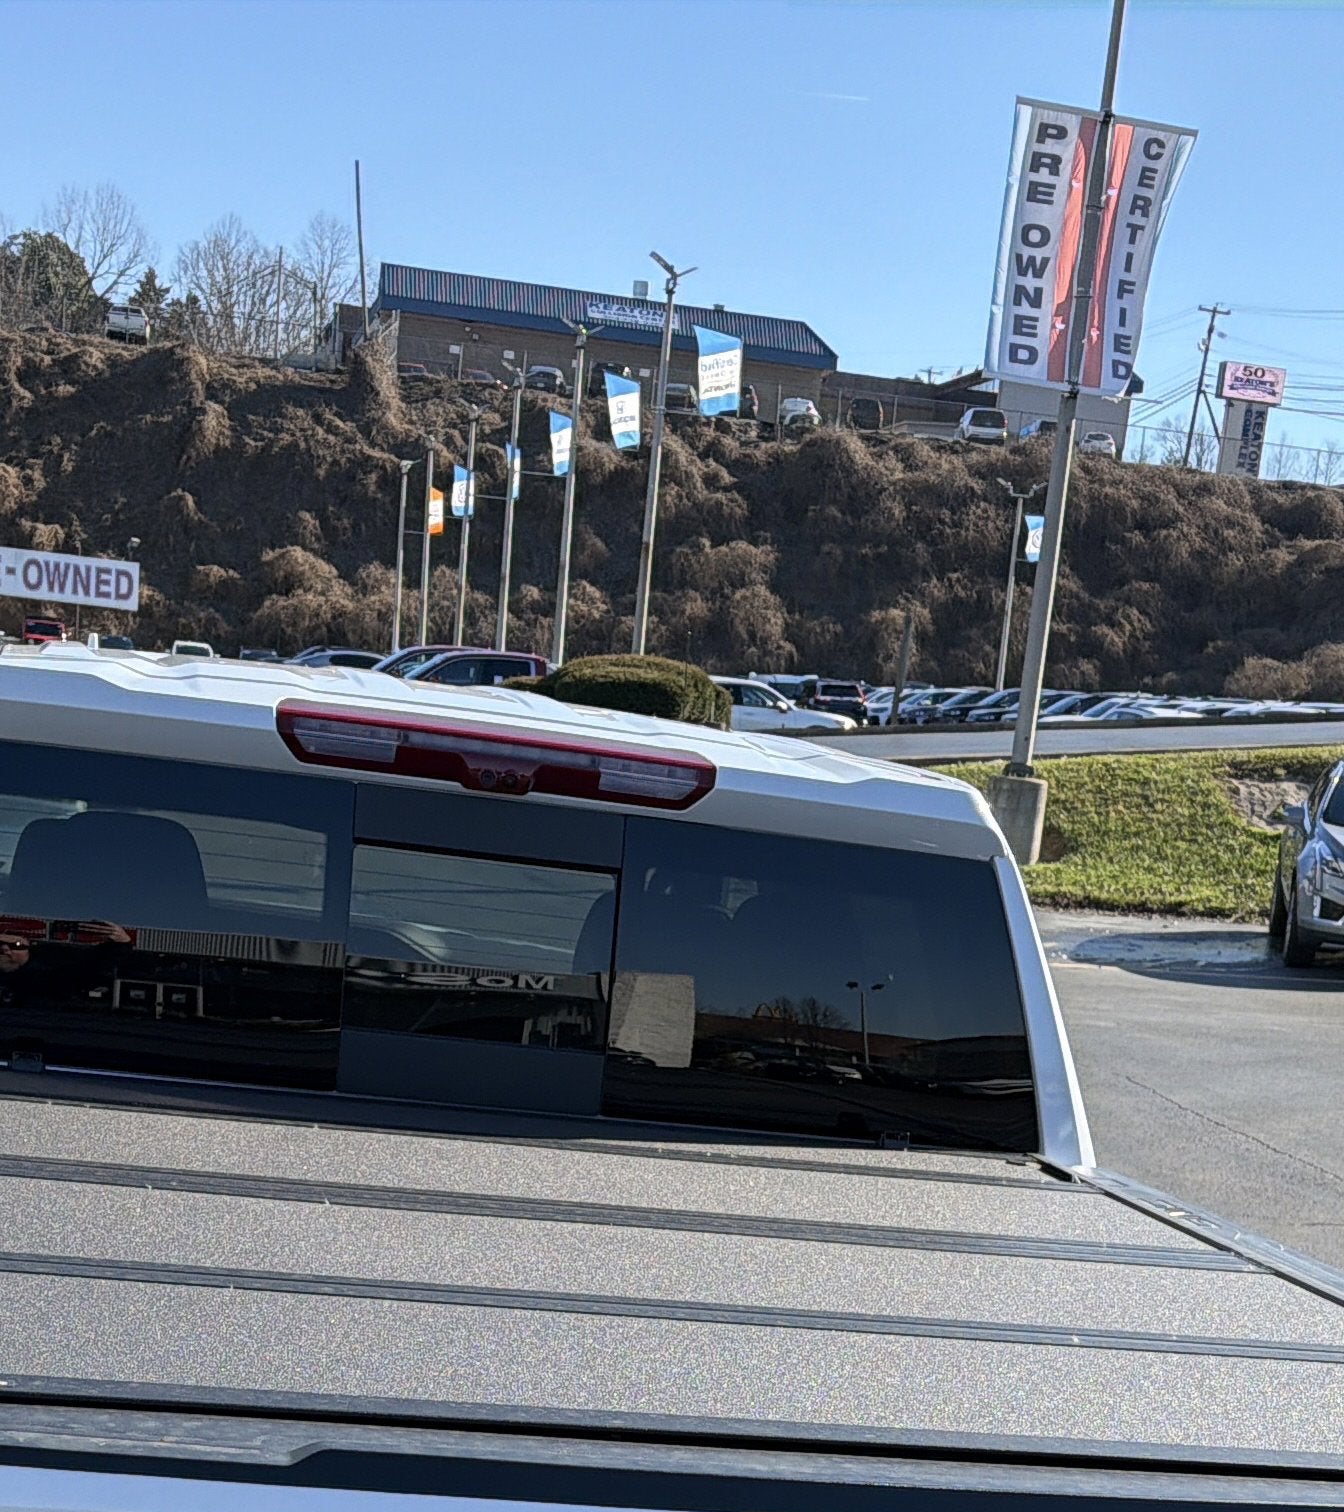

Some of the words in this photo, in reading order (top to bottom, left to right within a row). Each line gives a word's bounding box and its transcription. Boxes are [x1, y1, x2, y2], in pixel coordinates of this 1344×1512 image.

[1028, 122, 1068, 206] PRE
[1008, 223, 1051, 366] OWNED
[1111, 137, 1166, 380] CERTIFIED
[1241, 365, 1265, 379] 50
